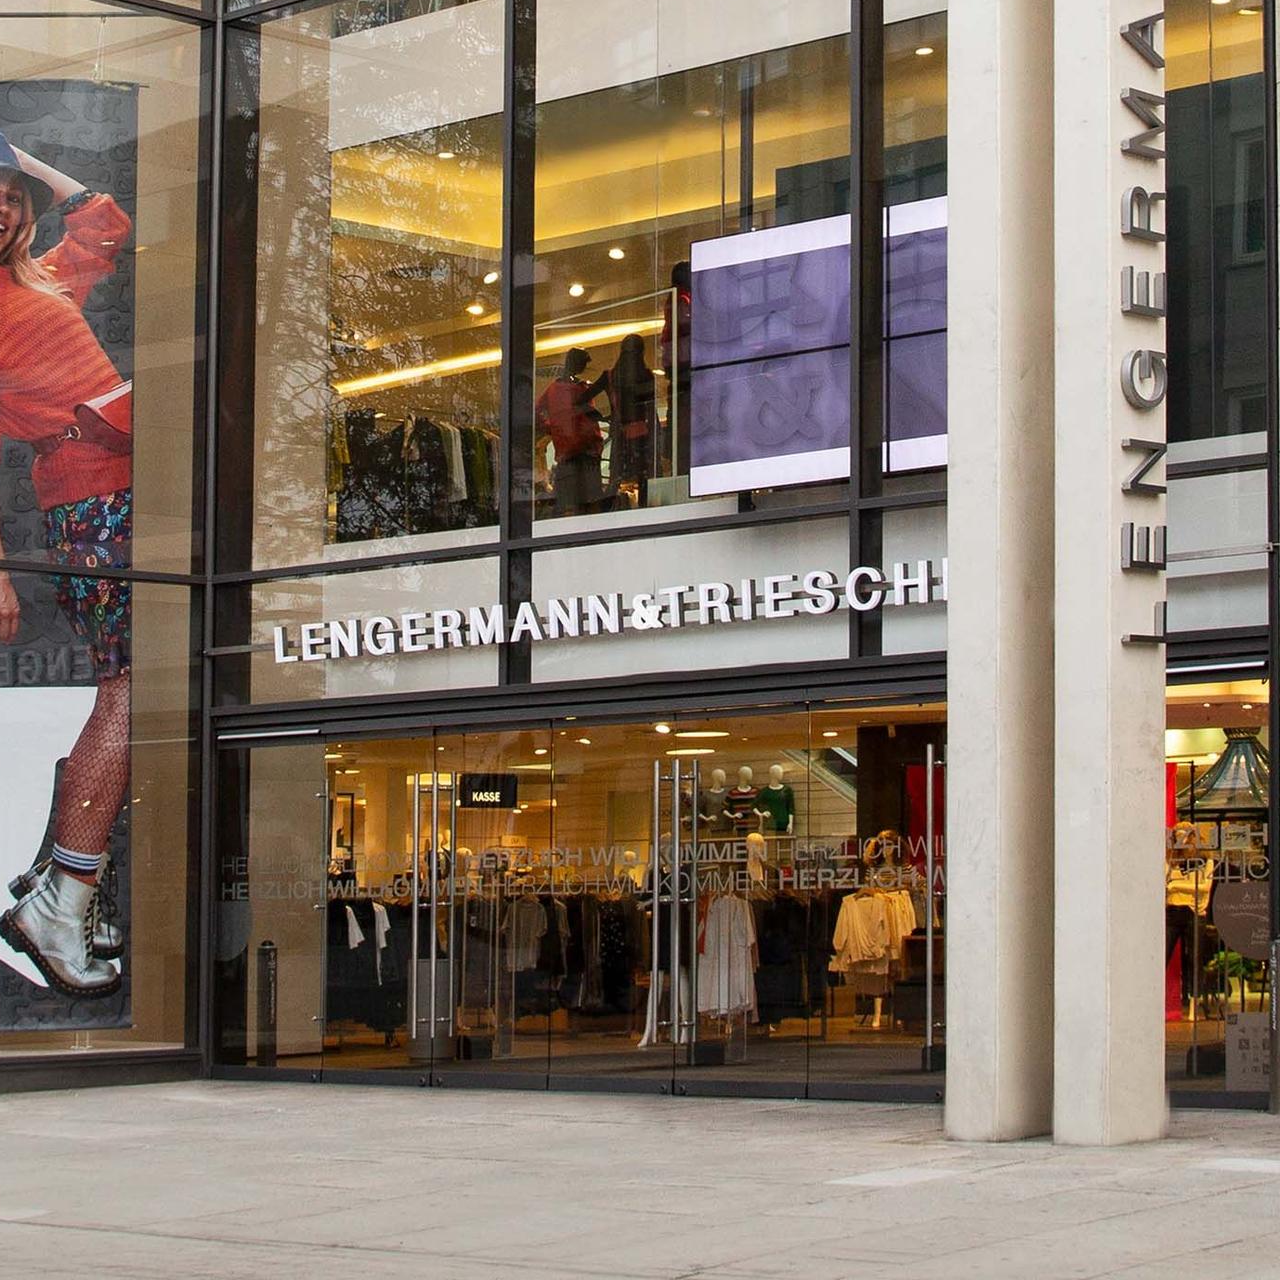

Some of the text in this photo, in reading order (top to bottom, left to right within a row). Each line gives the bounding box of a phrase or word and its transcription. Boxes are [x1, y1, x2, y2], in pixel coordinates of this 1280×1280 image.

[273, 557, 948, 663] LENGERMANN&TRIESCH
[472, 791, 501, 802] KASSE
[777, 835, 901, 861] HERZLICH
[778, 865, 918, 891] HERZLICH
